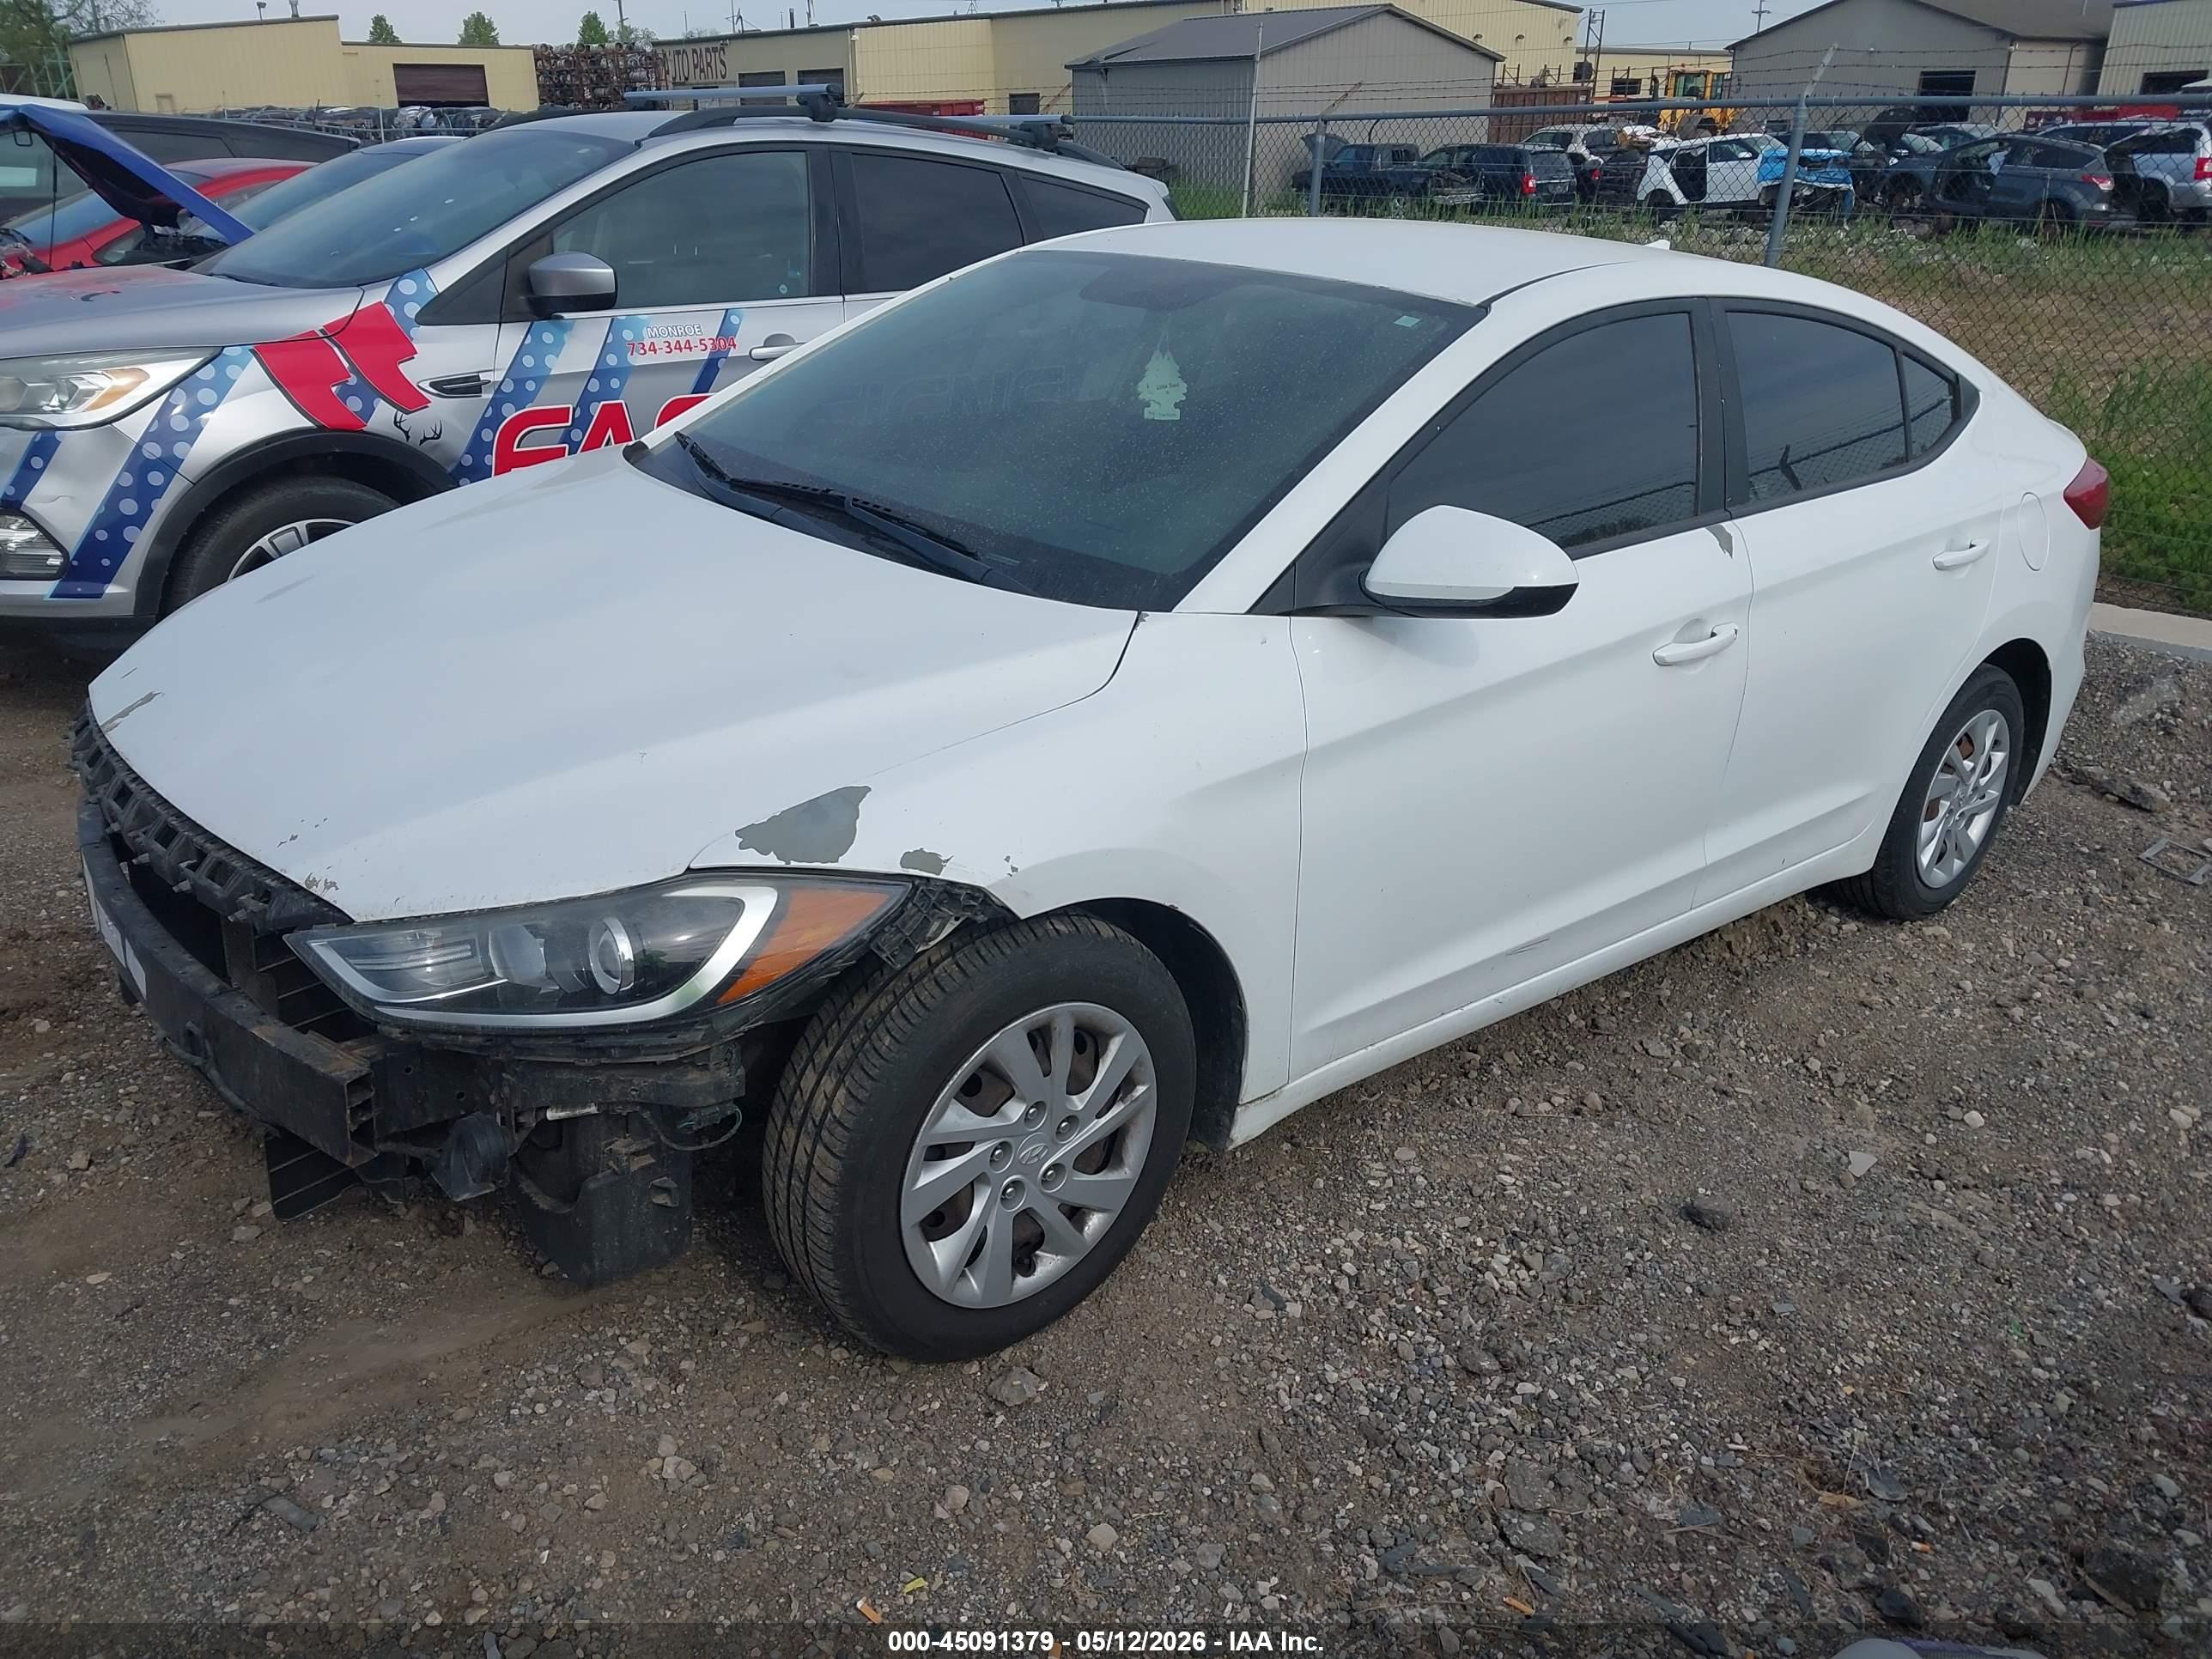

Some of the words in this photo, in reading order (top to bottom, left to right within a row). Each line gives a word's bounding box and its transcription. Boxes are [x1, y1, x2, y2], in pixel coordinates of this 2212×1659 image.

[691, 46, 727, 80] PARTS
[647, 324, 703, 338] MONROE
[627, 336, 738, 356] 734-344-5304
